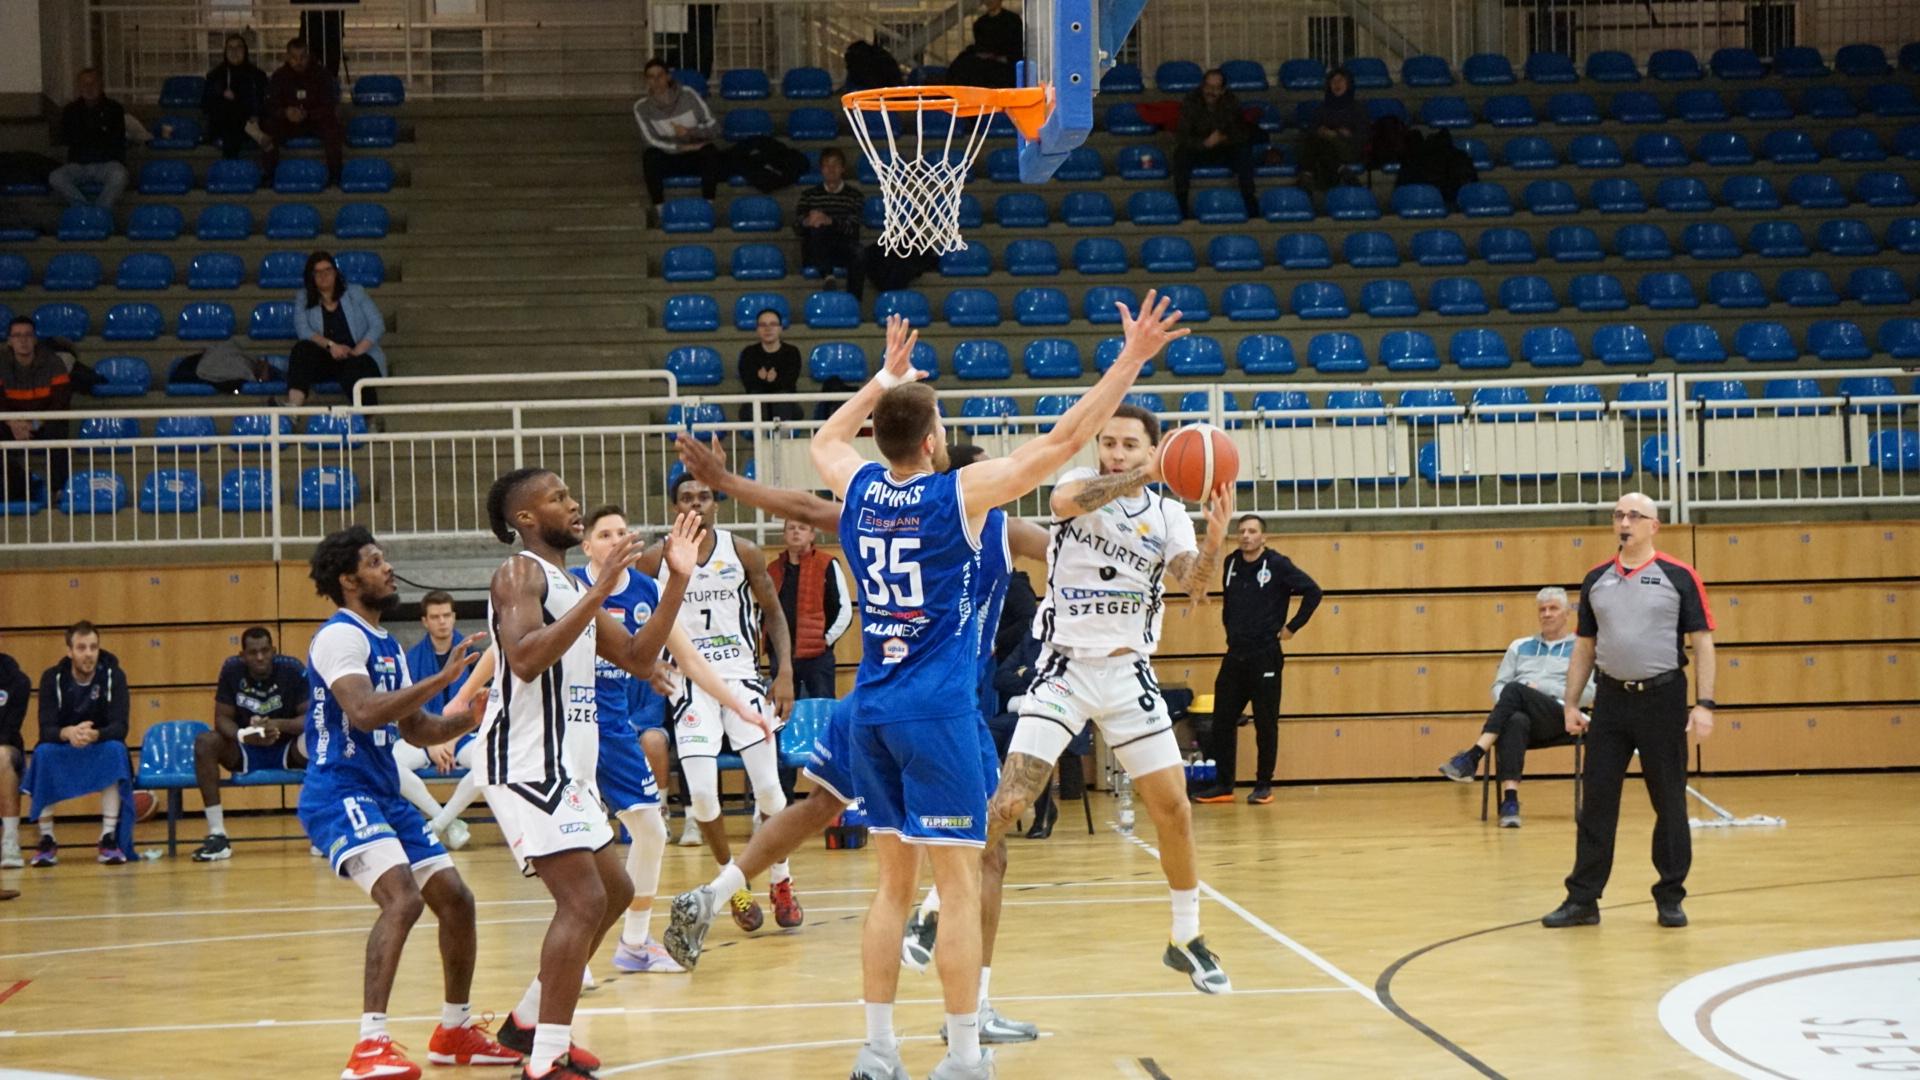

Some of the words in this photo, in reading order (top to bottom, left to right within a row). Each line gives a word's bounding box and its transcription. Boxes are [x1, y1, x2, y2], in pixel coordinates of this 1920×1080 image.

[1066, 526, 1154, 575] NATURTEX
[859, 536, 925, 607] 35
[683, 590, 735, 603] TURTEX
[1069, 602, 1140, 616] SZEGED
[701, 609, 711, 630] 7
[864, 623, 926, 638] ALANEX
[750, 697, 762, 713] 7
